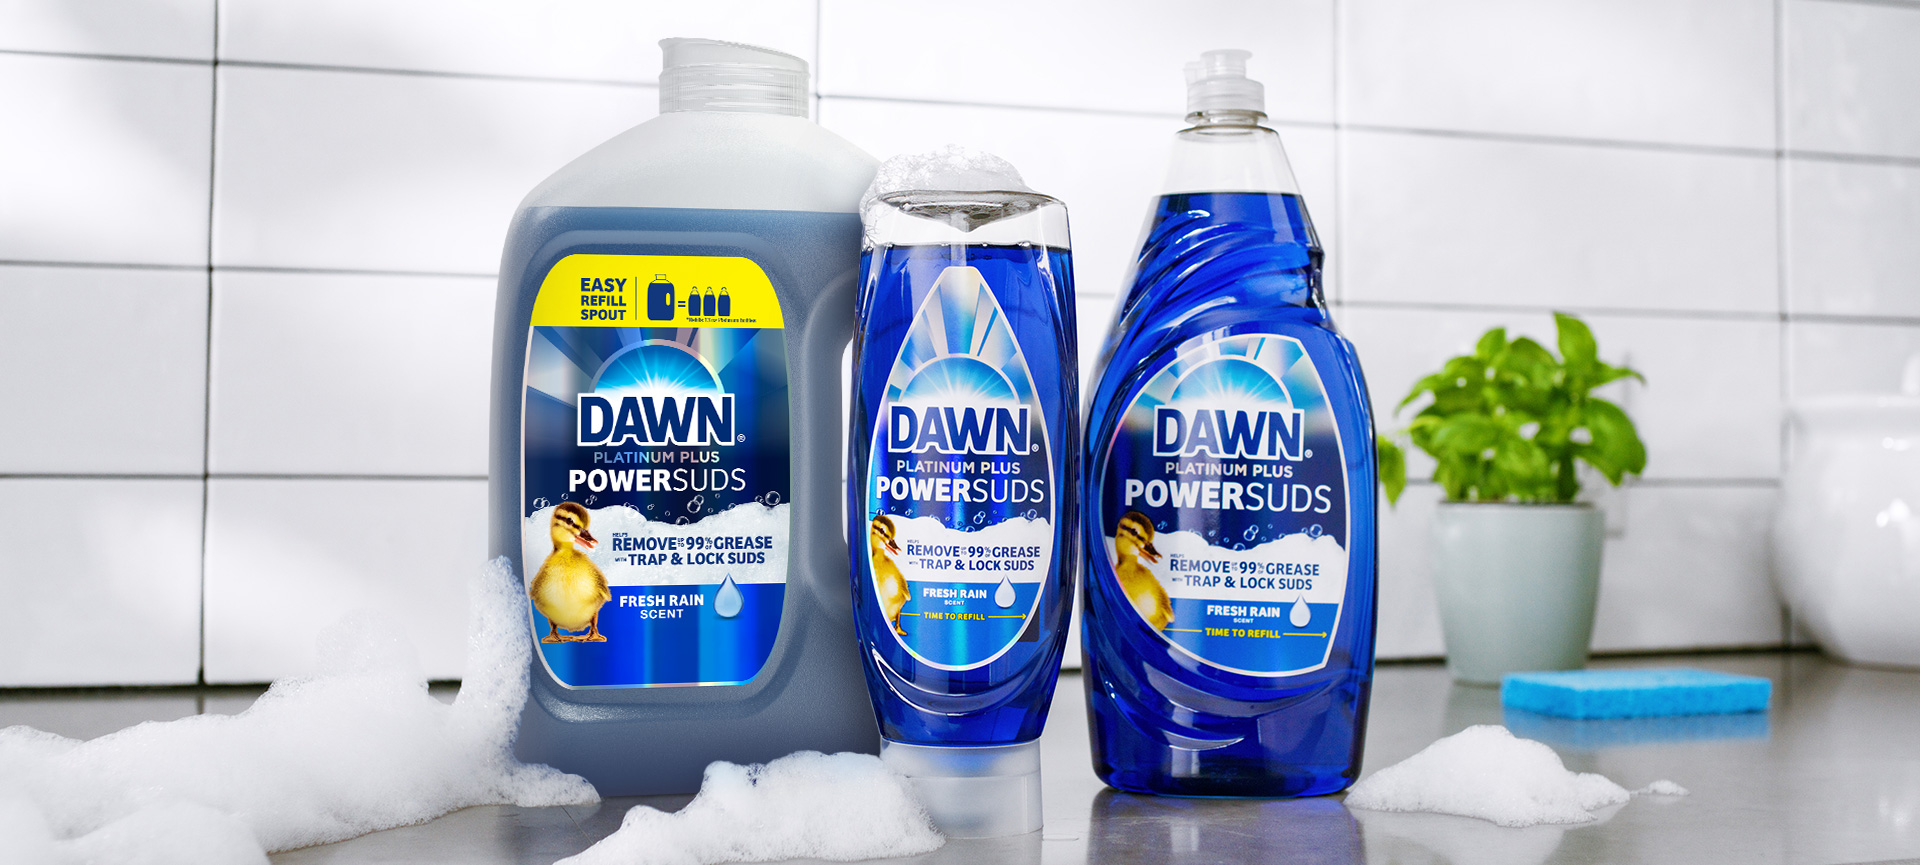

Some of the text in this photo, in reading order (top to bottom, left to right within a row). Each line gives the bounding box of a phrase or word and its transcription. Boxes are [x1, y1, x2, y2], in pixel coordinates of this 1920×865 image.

[581, 278, 627, 292] EASY
[581, 295, 627, 307] REFILL
[581, 309, 627, 321] SPOUT
[594, 451, 720, 464] PLATINUM PLUS
[896, 460, 1021, 475] PLATINUM PLUS
[1165, 462, 1293, 478] PLATINUM PLUS
[612, 537, 677, 551] REMOVE
[714, 536, 773, 550] GREASE
[907, 544, 960, 557] REMOVE
[992, 546, 1041, 558] GREASE
[628, 553, 668, 566] TRAP
[670, 552, 683, 565] &
[687, 552, 725, 565] LOCK
[727, 552, 765, 564] SUDS
[919, 559, 951, 570] TRAP
[955, 560, 965, 570] &
[969, 560, 1001, 571] LOCK
[1003, 560, 1035, 571] SUDS
[1170, 559, 1231, 573] REMOVE
[1266, 562, 1320, 576] GREASE
[1184, 575, 1221, 587] TRAP
[1224, 576, 1236, 588] &
[1240, 577, 1275, 589] LOCK
[1278, 578, 1312, 590] SUDS
[923, 588, 987, 599] FRESH RAIN
[619, 594, 704, 607] FRESH RAIN
[640, 609, 684, 619] SCENT
[924, 612, 986, 621] TIME TO REFILL
[1207, 605, 1280, 618] FRESH RAIN
[1205, 628, 1280, 638] TIME TO REFILL
